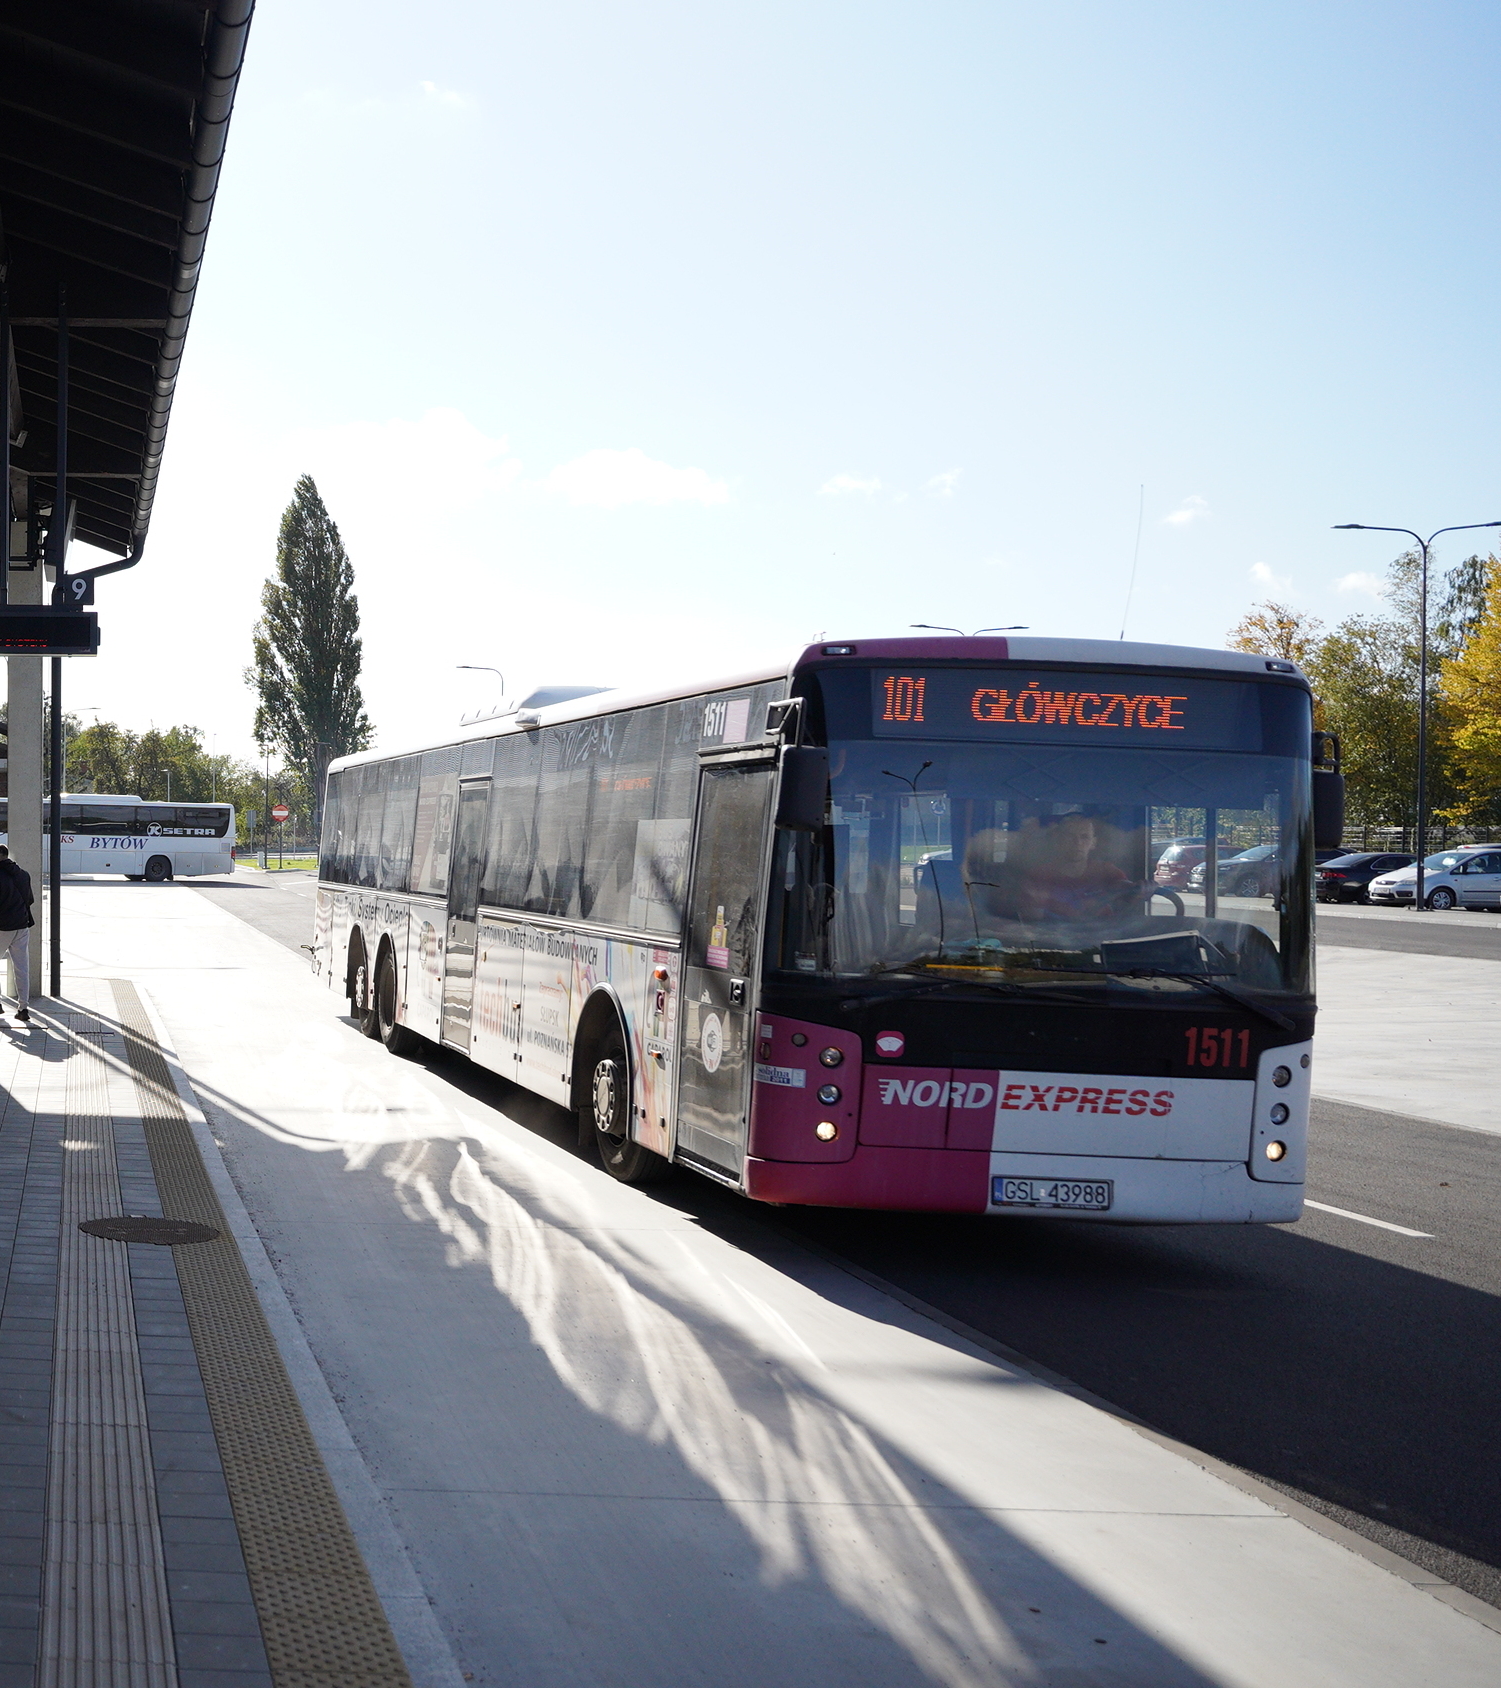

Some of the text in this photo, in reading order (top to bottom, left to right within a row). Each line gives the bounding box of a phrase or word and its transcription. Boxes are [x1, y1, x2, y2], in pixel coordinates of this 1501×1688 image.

[71, 578, 87, 600] 9
[882, 676, 1188, 729] 101 GŁÓWCZYCE
[703, 701, 727, 737] 1511
[60, 835, 148, 850] KS BYTÓW
[162, 828, 216, 836] SETRA
[1184, 1027, 1249, 1068] 1511
[879, 1078, 1175, 1117] NORD EXPRESS
[1004, 1181, 1106, 1204] GSL 43988
